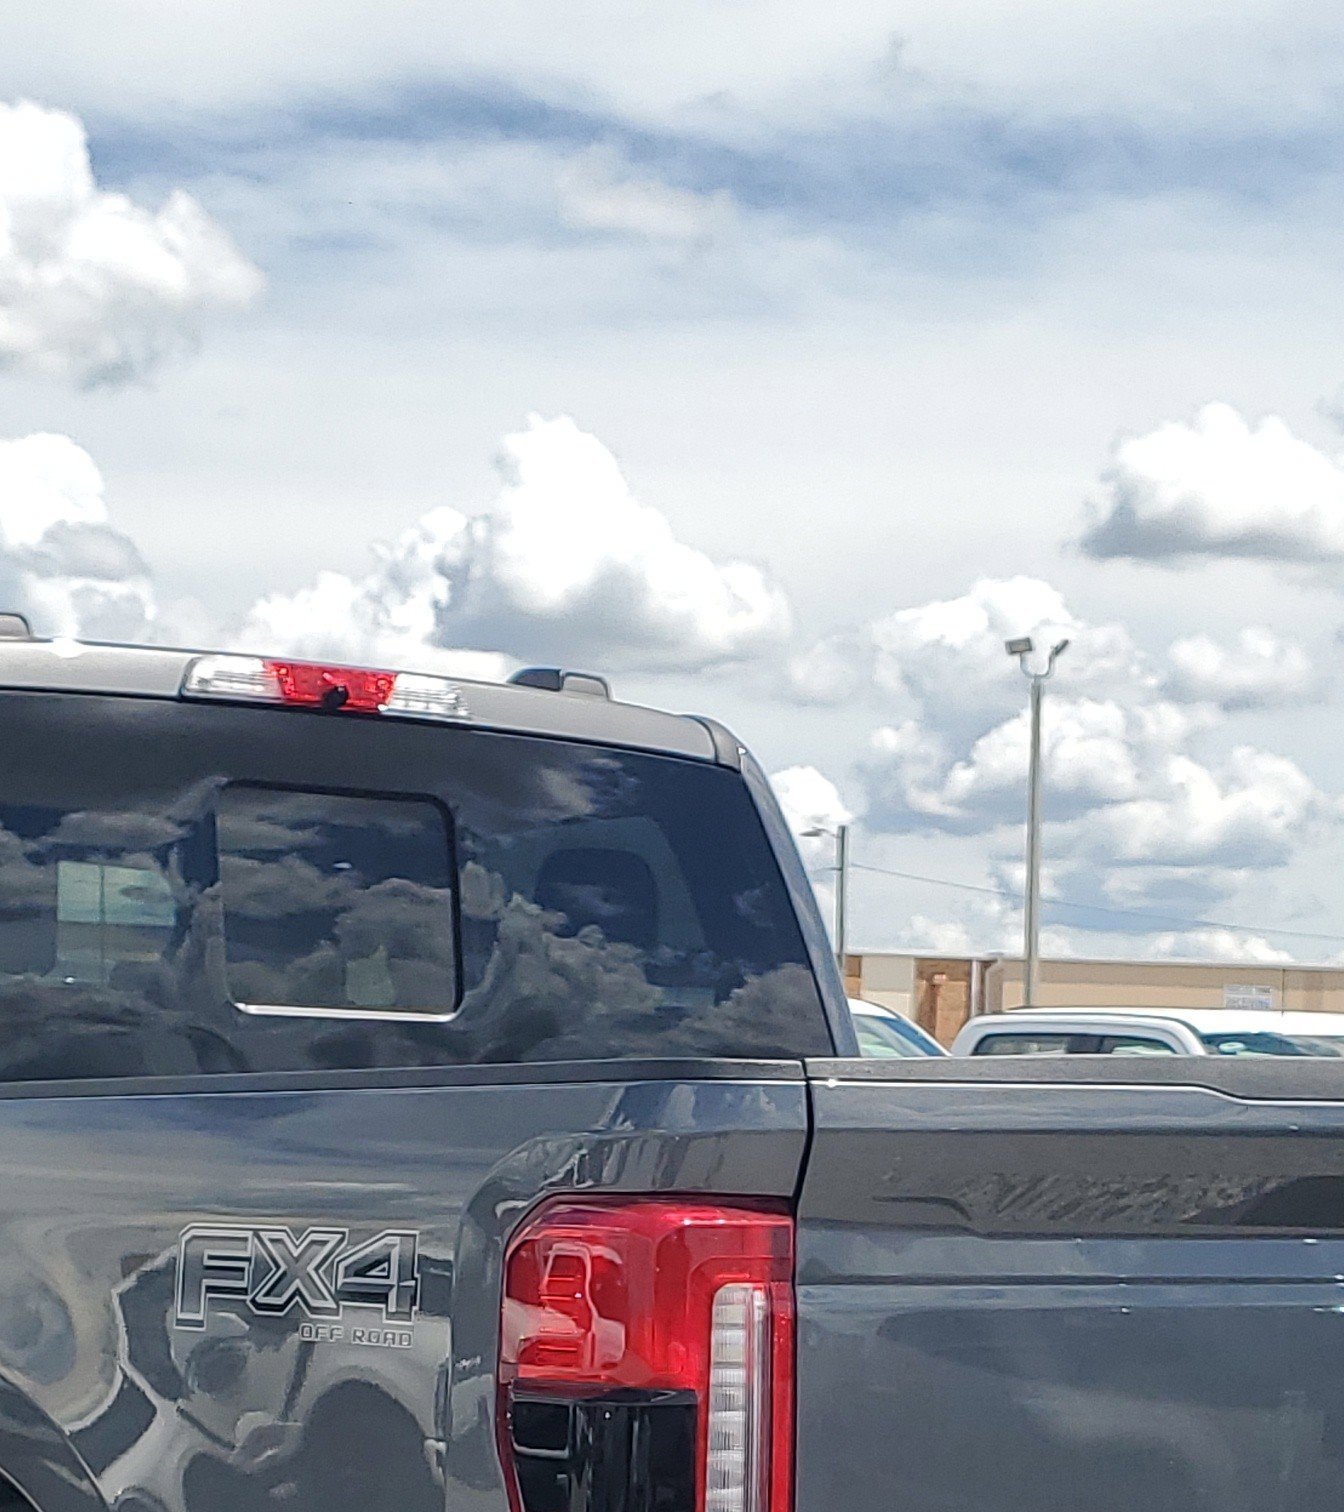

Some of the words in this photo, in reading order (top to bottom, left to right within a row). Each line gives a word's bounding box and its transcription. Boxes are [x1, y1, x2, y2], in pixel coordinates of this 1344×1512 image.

[174, 1222, 421, 1331] FX4
[301, 1323, 342, 1341] OFF
[352, 1329, 411, 1347] ROAD
